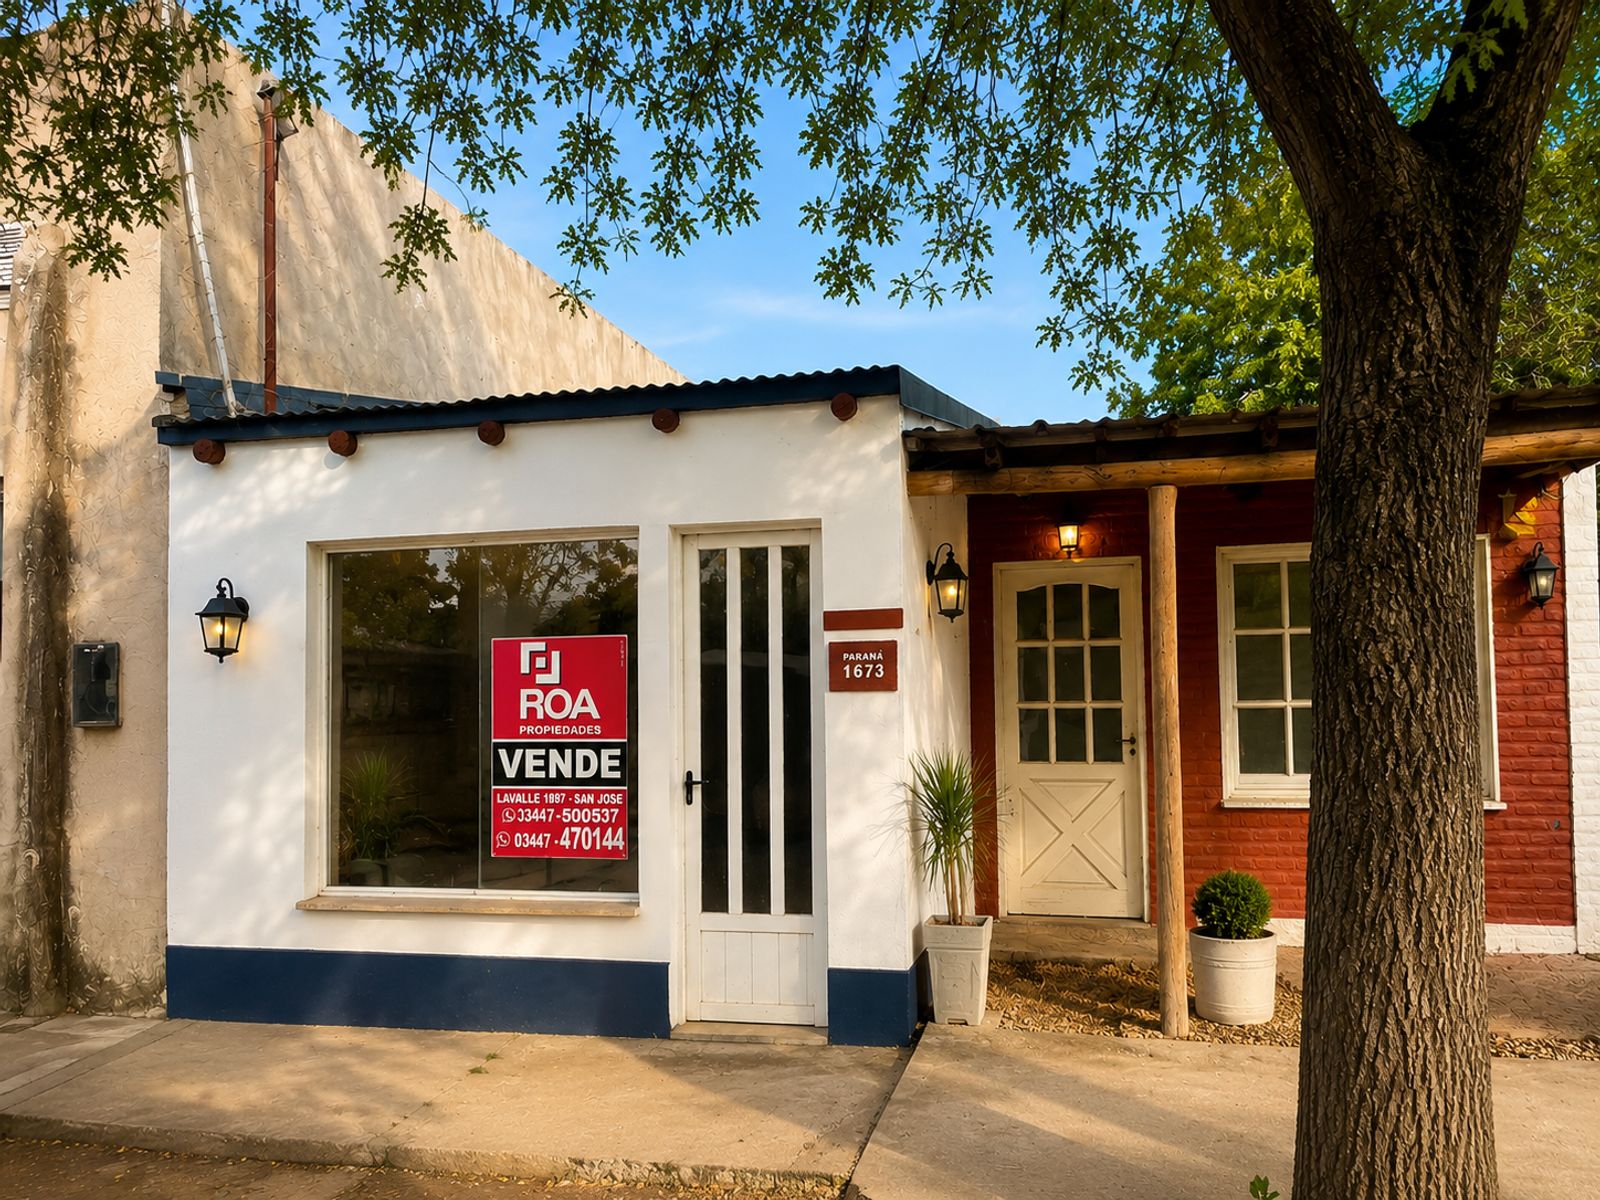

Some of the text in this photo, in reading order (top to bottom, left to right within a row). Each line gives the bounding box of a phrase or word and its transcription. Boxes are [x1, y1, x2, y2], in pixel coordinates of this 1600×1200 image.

[843, 649, 883, 661] PARANÁ
[843, 664, 884, 678] 1673
[520, 688, 600, 720] ROA
[520, 725, 601, 735] PROPIEDADES
[498, 748, 621, 778] VENDE
[496, 793, 540, 804] LAVALLE
[574, 793, 594, 804] SAN
[597, 793, 623, 804] JOSE
